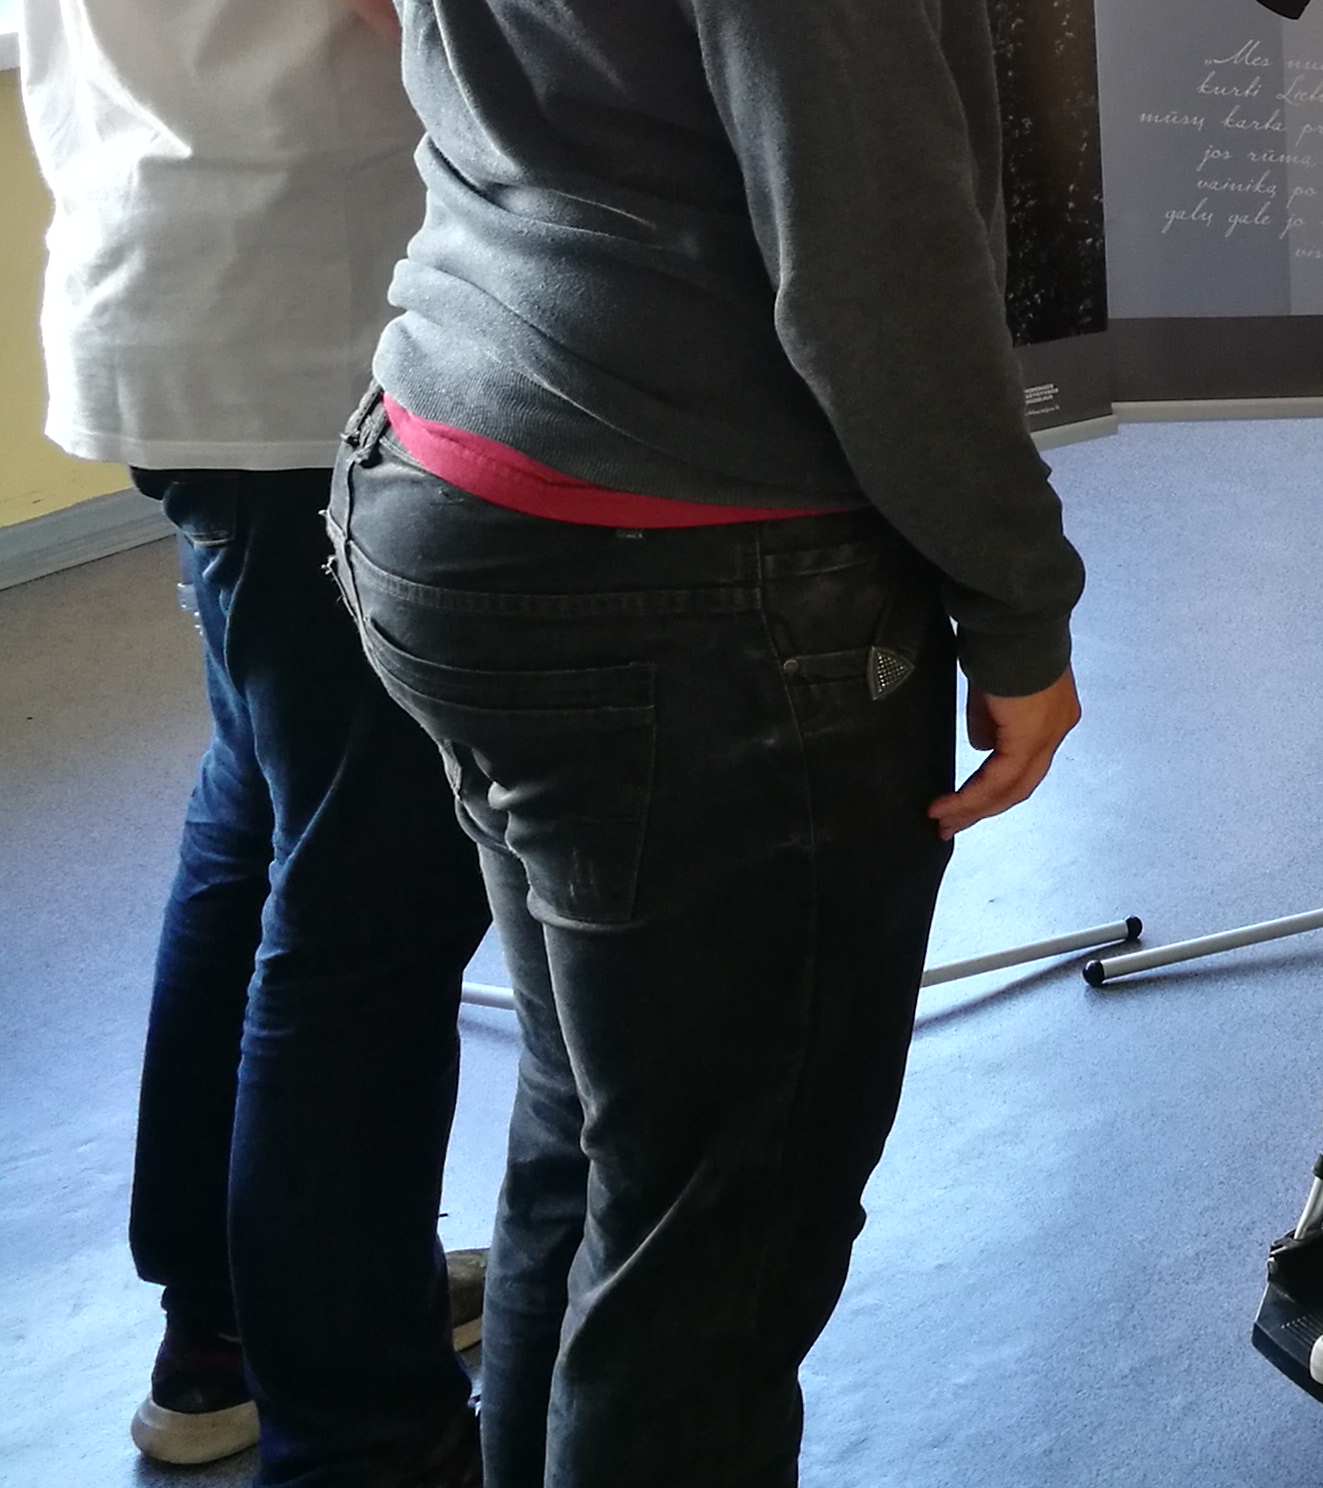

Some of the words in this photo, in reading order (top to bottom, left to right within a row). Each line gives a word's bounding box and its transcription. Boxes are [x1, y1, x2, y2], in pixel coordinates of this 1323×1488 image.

[1197, 70, 1261, 98] kurti
[1221, 105, 1286, 132] karta
[1196, 145, 1233, 172] jos
[1286, 184, 1316, 209] po
[1225, 201, 1272, 238] gale
[1279, 211, 1305, 240] jo
